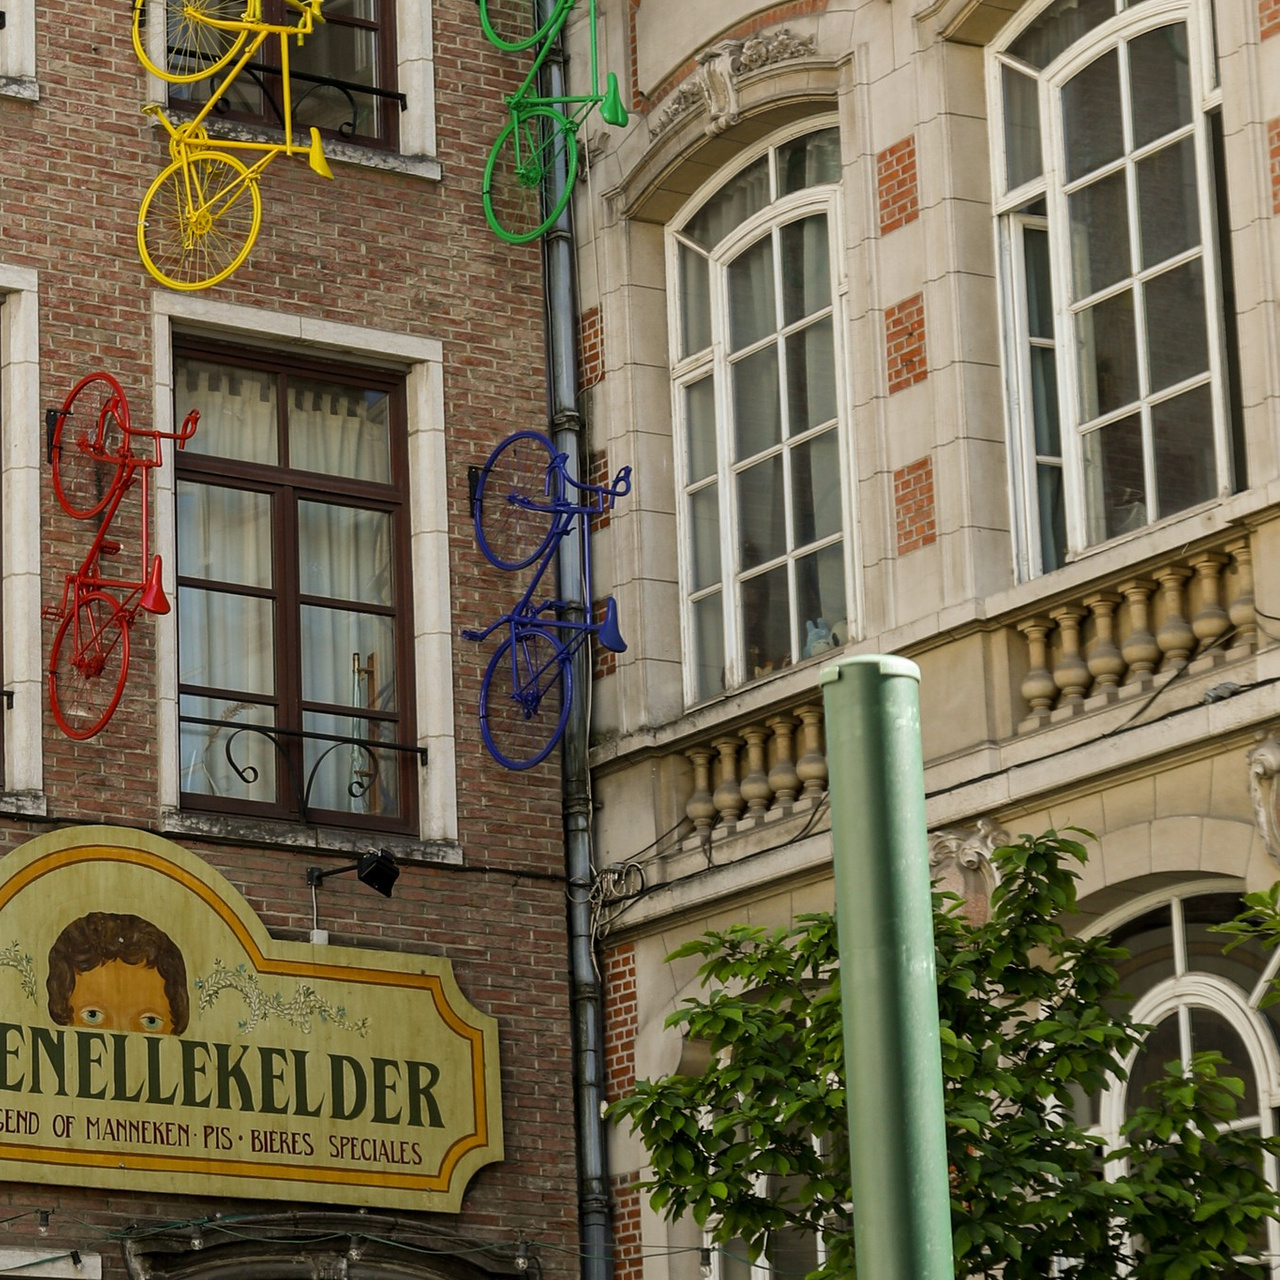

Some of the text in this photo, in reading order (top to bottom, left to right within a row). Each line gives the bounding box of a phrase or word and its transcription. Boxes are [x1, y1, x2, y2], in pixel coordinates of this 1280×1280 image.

[52, 1113, 75, 1139] OF
[86, 1116, 190, 1148] MANNEKEN
[203, 1125, 233, 1150] PIS
